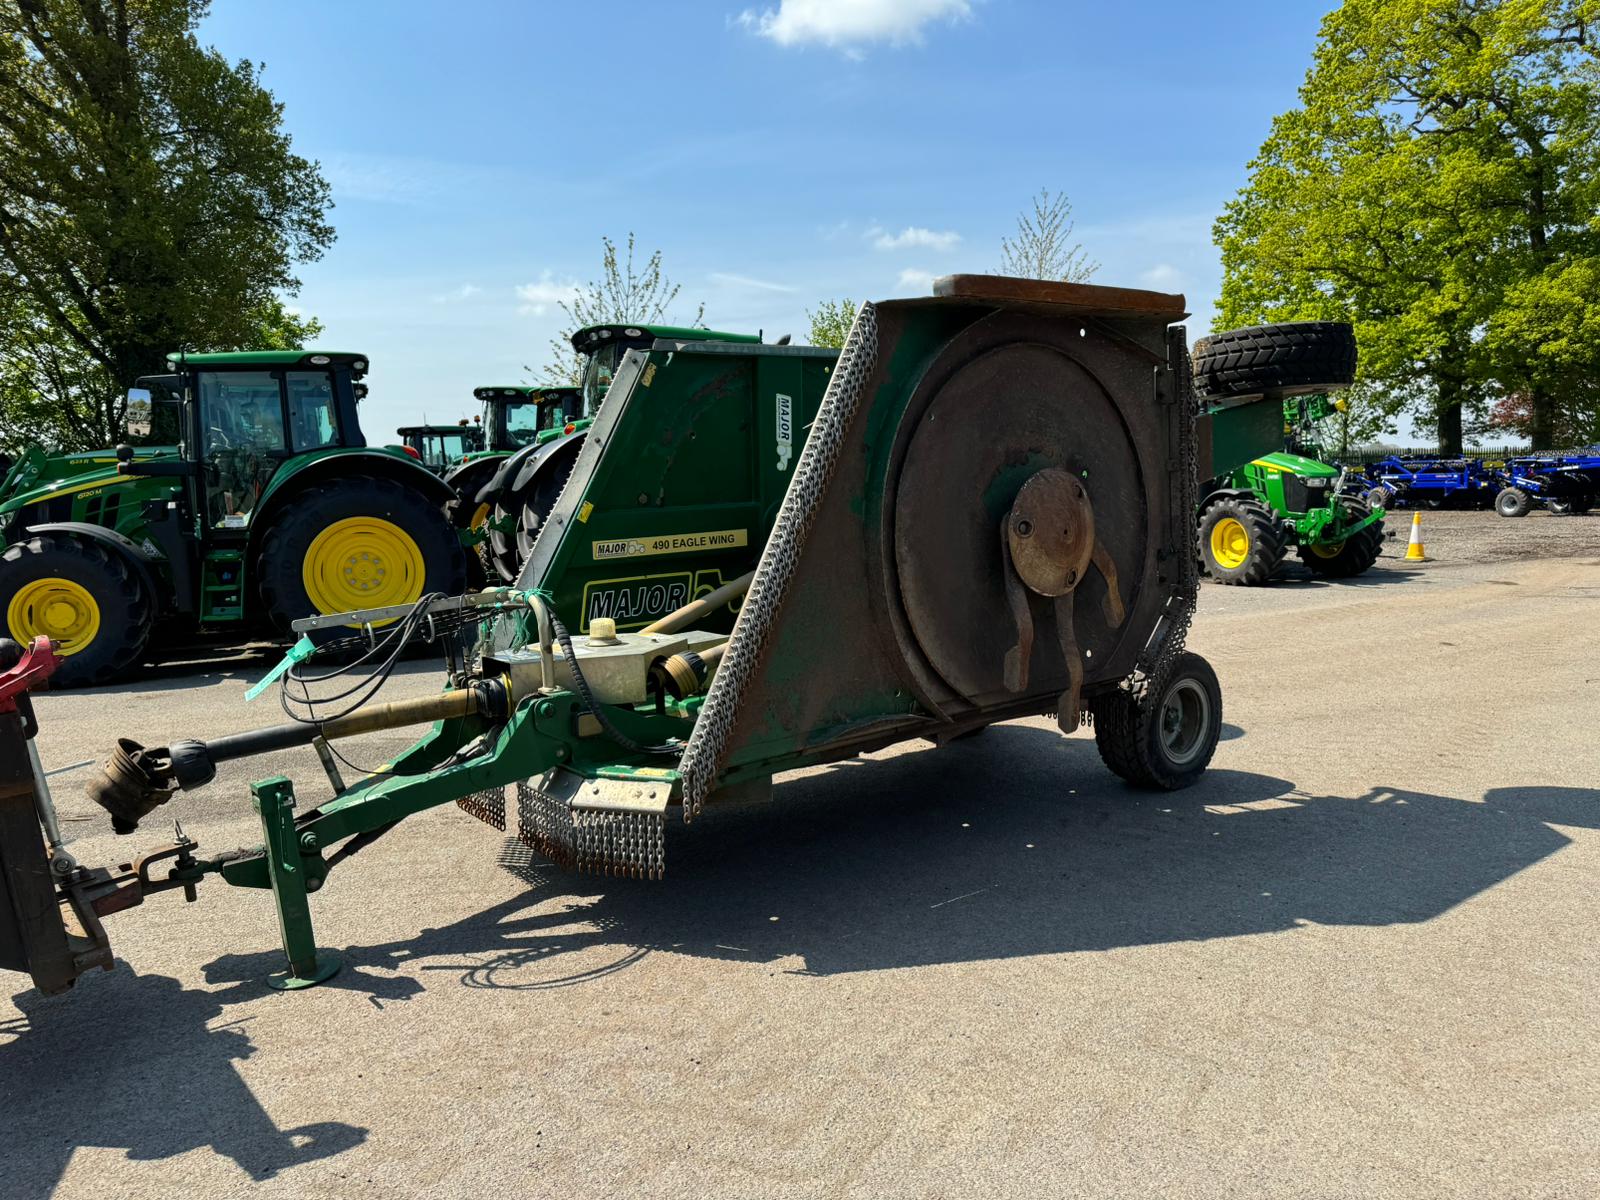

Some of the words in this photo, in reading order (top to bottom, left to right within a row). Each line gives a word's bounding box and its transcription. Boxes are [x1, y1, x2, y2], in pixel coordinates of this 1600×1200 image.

[780, 397, 790, 441] MAJOR
[597, 542, 627, 554] MAJOR
[652, 540, 670, 550] 490
[672, 537, 706, 549] EAGLE
[708, 534, 735, 545] WING
[588, 583, 686, 622] MAJOR
